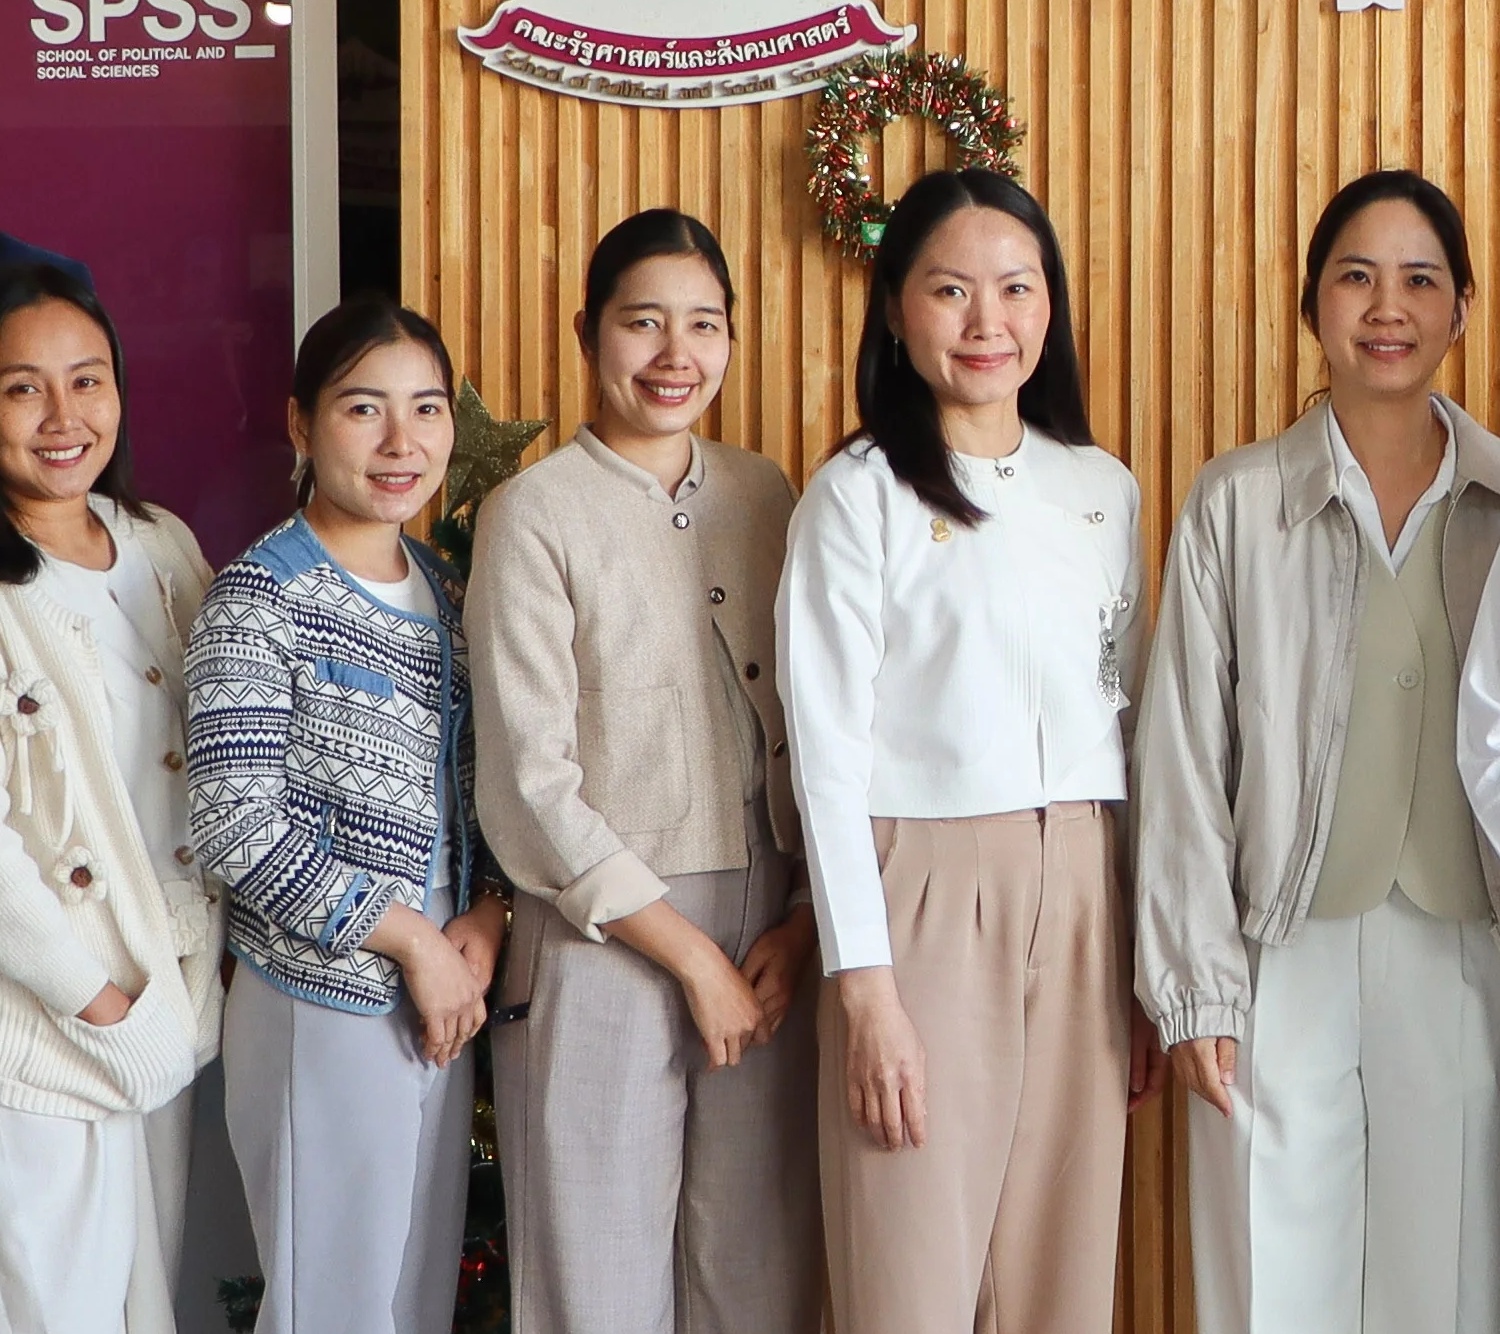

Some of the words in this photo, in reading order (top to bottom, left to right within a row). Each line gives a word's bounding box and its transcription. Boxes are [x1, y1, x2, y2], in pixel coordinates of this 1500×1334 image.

[513, 7, 852, 69] คณะรัฐศาสตร์และสังคมศาสตร์
[36, 48, 94, 64] SCHOOL
[98, 48, 118, 62] OF
[121, 46, 192, 62] POLITICAL
[195, 46, 226, 60] AND
[36, 65, 87, 80] SOCIAL
[90, 63, 160, 79] SCIENCES
